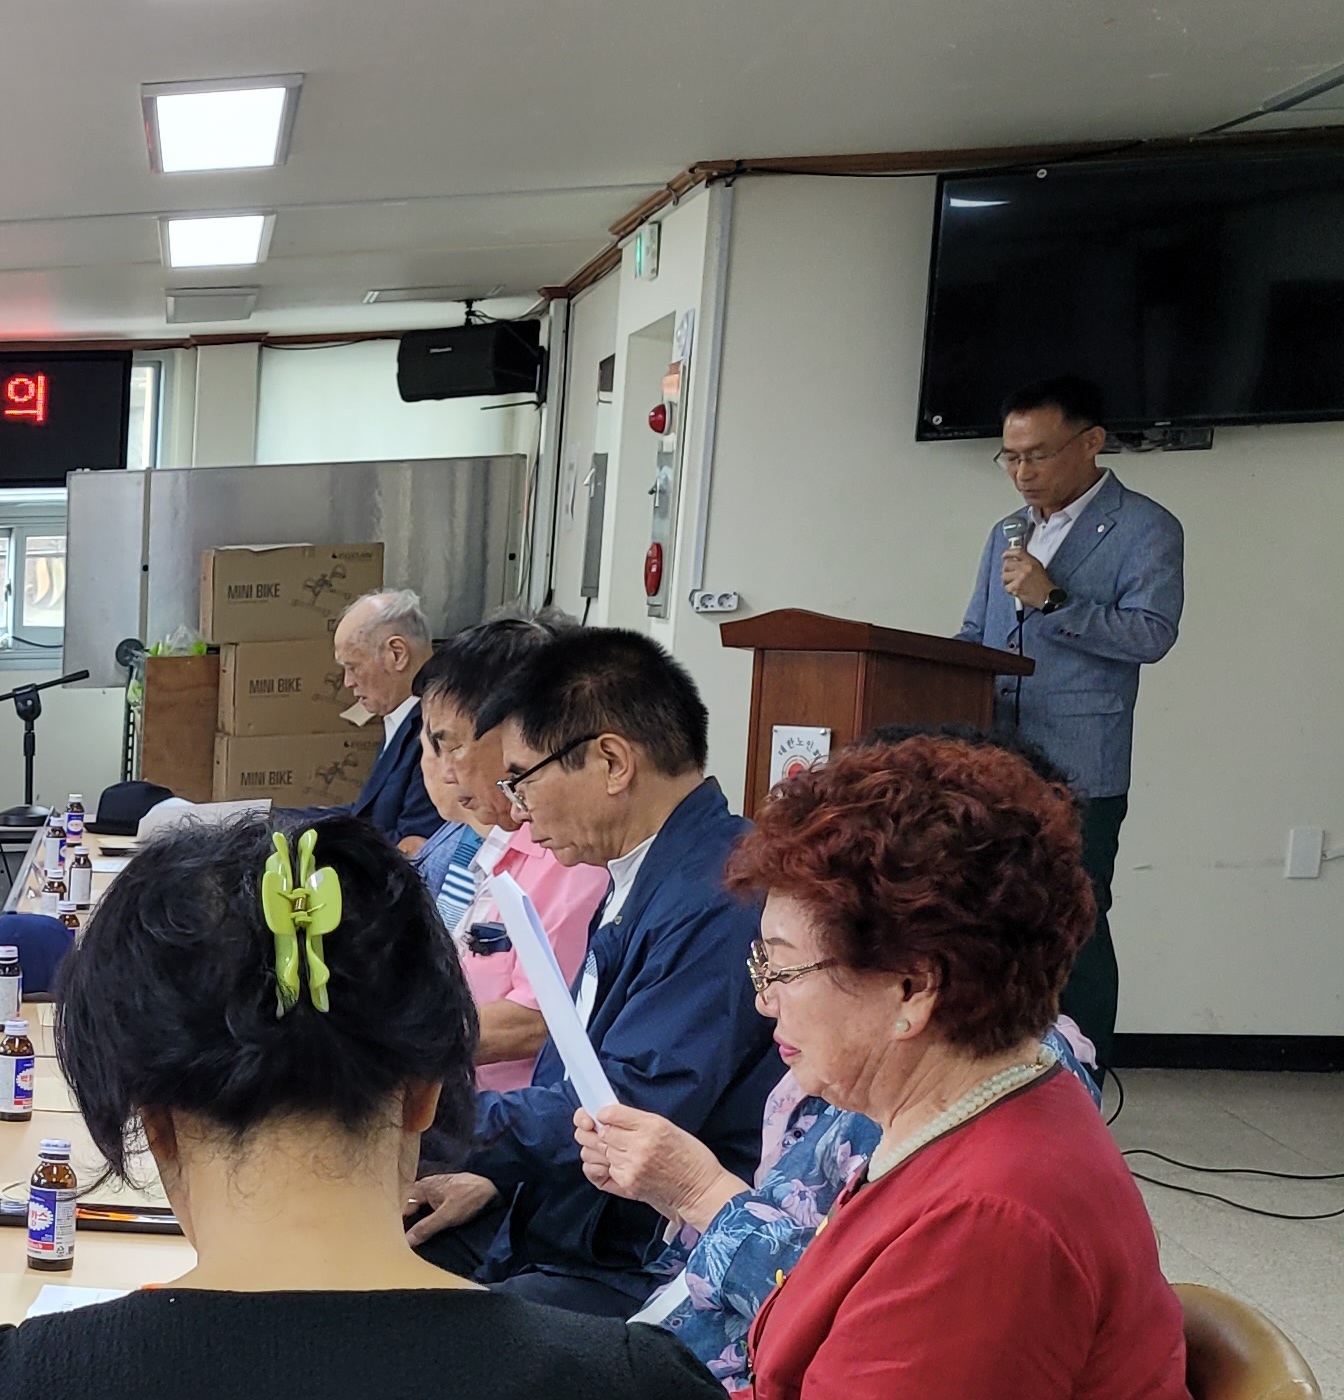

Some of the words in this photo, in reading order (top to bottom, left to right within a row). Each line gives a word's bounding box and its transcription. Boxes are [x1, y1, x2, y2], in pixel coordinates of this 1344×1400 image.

[228, 584, 253, 599] MINI
[256, 583, 281, 598] BIKE
[249, 679, 274, 694] MINI
[277, 677, 302, 693] BIKE
[240, 771, 265, 786] MINI
[268, 770, 293, 786] BIKE
